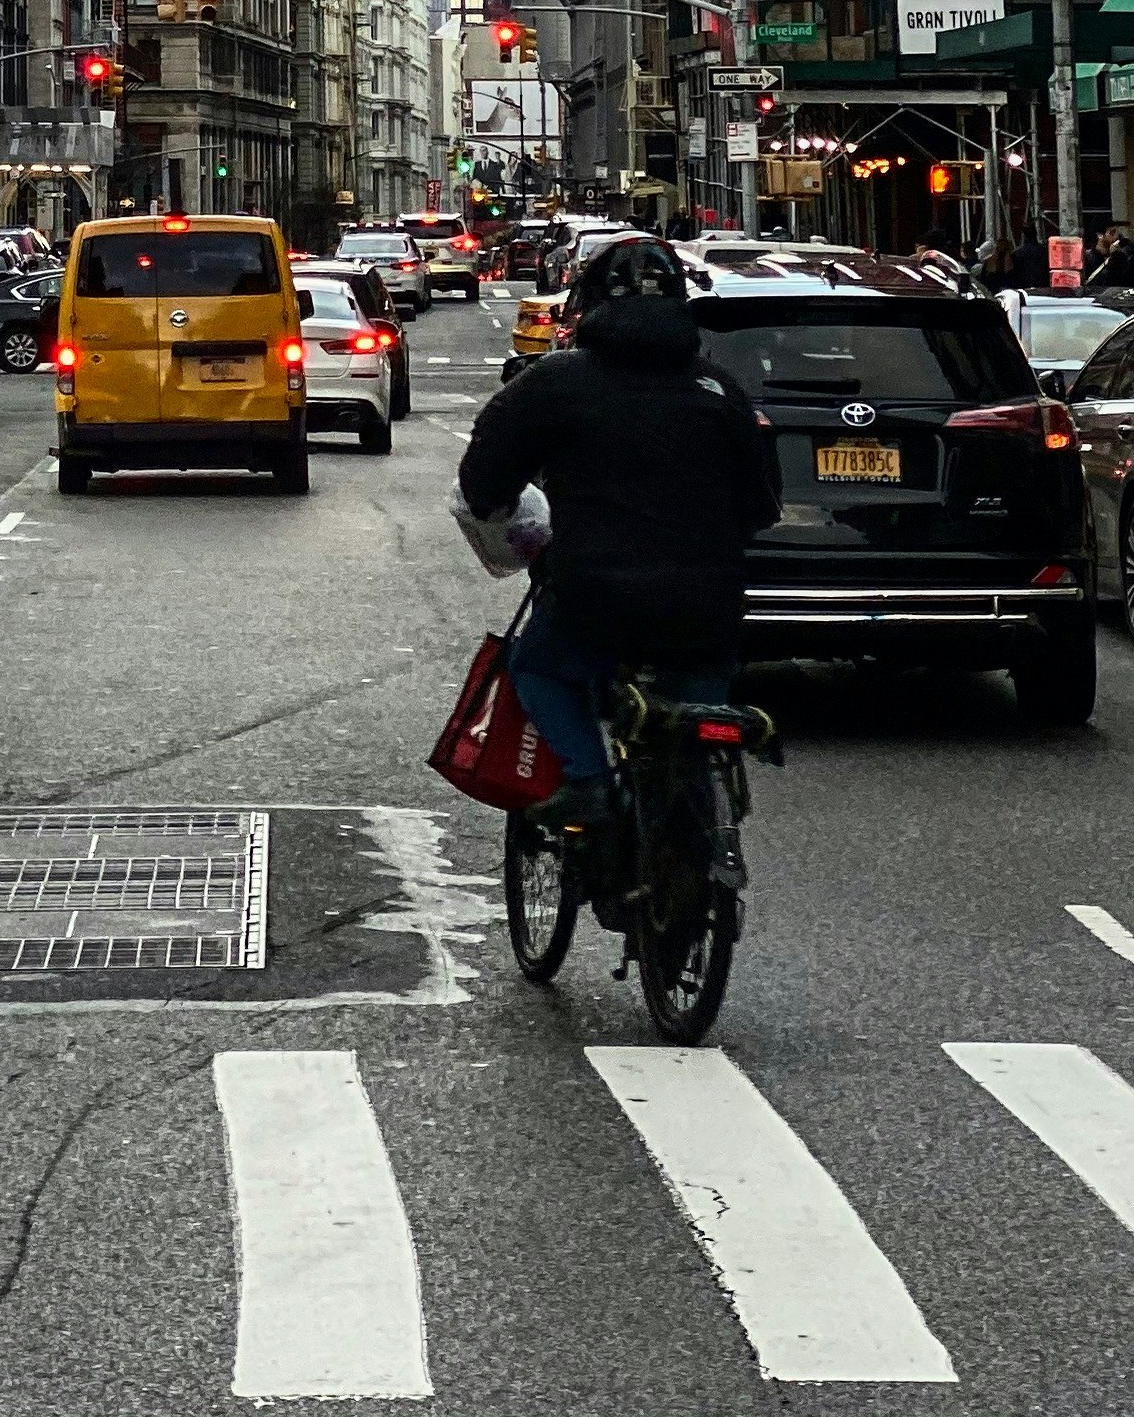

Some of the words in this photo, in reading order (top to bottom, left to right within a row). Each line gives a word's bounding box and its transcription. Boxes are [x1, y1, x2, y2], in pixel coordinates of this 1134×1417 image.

[906, 10, 944, 29] GRAN
[758, 24, 813, 36] Cleveland
[718, 74, 740, 84] ONE
[749, 73, 773, 84] WAY
[822, 450, 895, 473] T778385C
